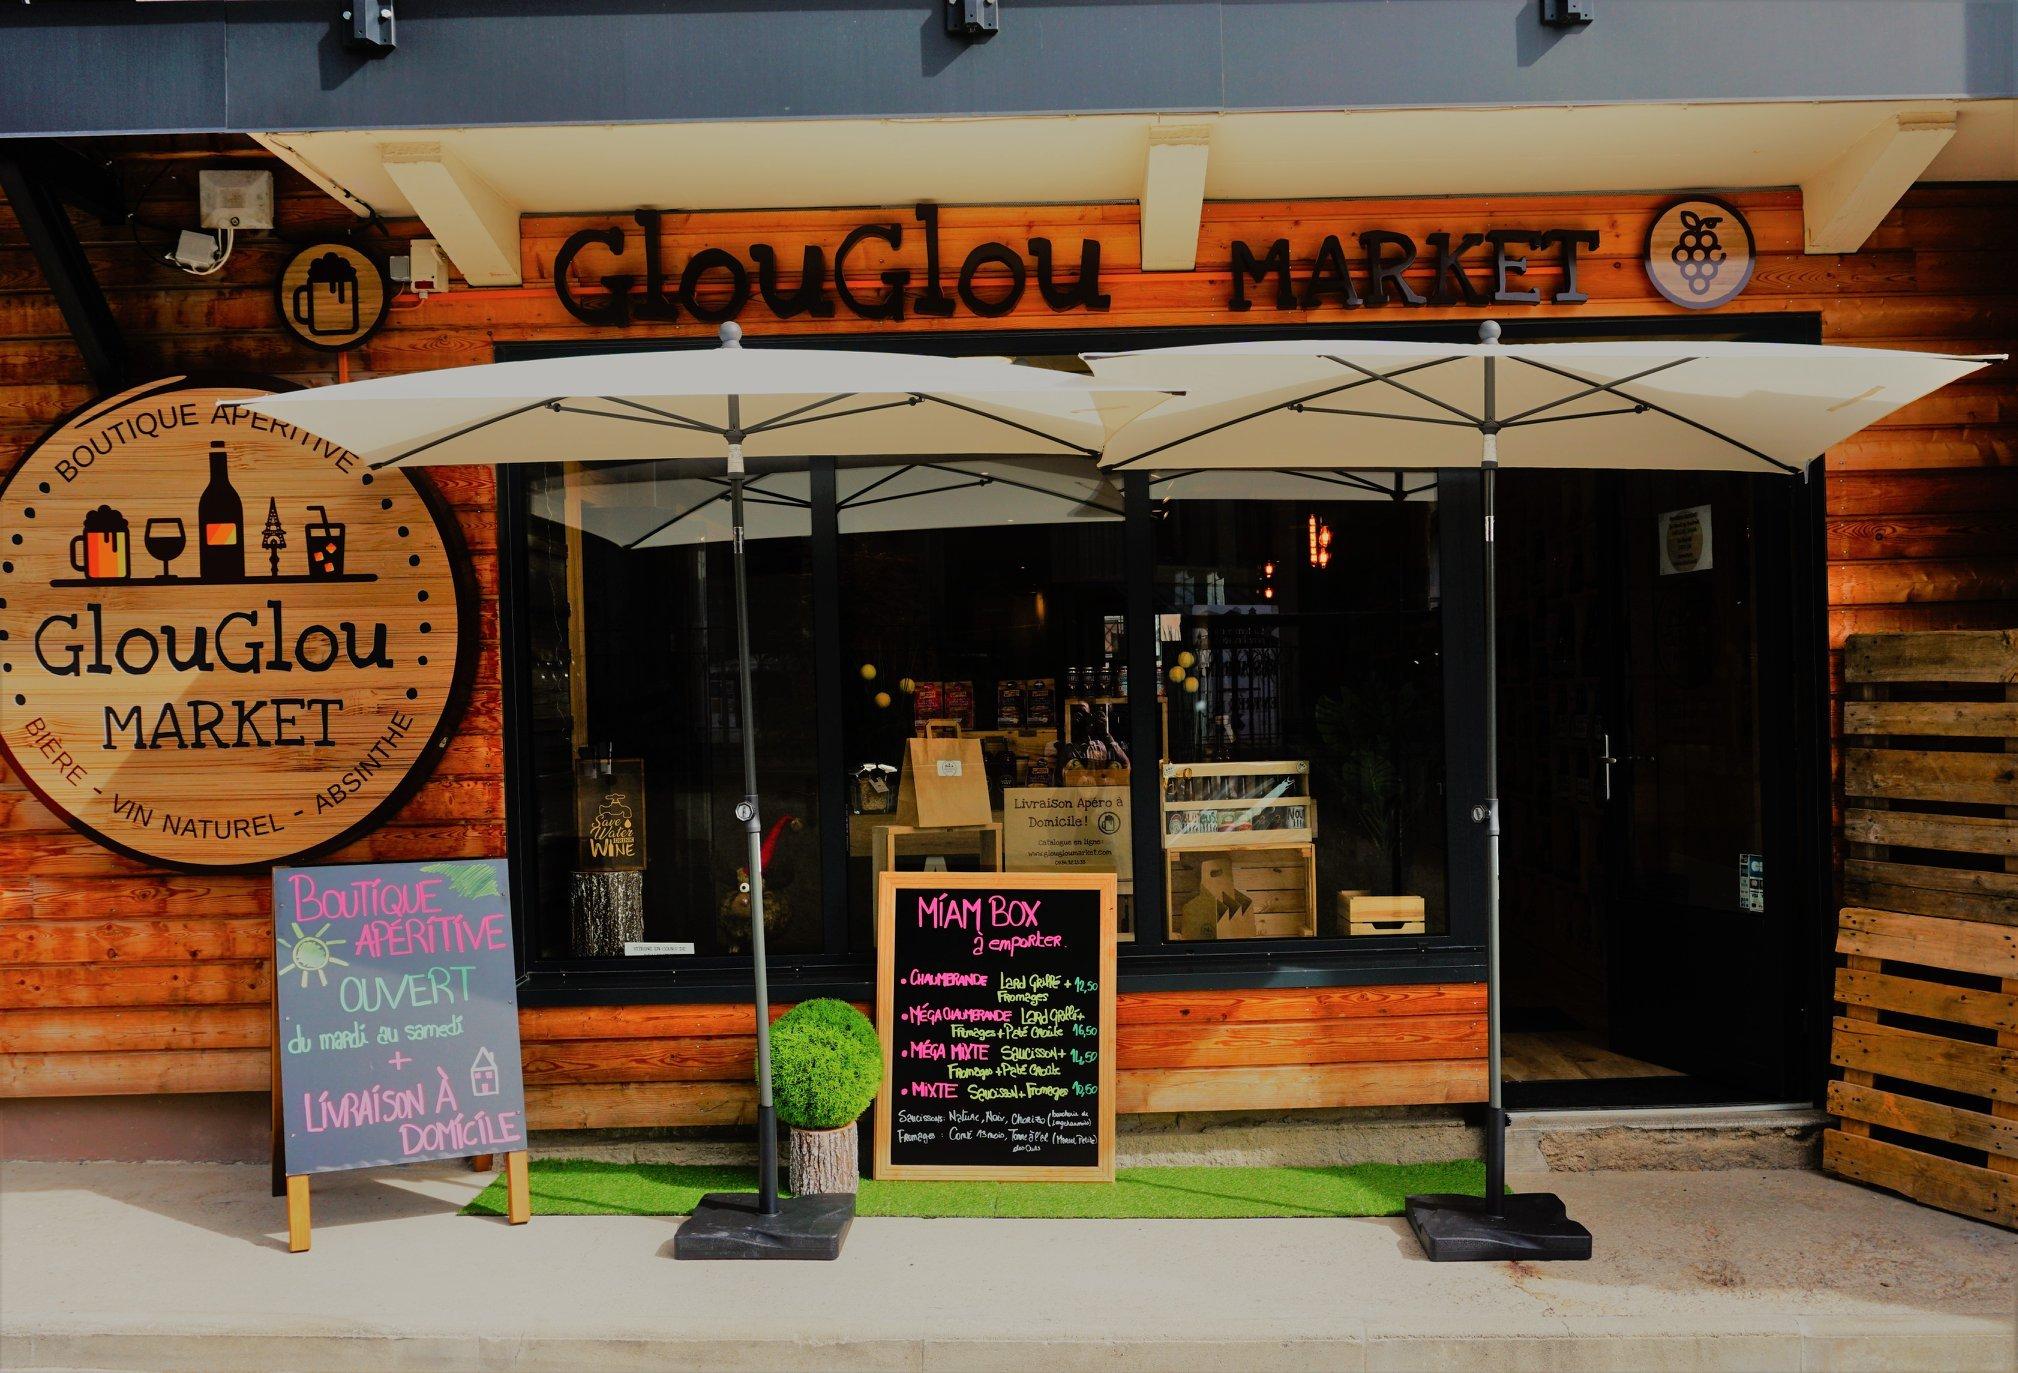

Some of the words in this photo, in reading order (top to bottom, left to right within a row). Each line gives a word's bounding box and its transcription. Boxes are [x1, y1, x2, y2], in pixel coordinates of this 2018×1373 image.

[555, 204, 1111, 327] GlouGlou
[1228, 230, 1600, 312] MARKET
[55, 403, 200, 483] BOUTIQUE
[35, 600, 394, 677] GlouGlou
[103, 698, 344, 750] MARKET
[25, 716, 88, 787] BIÈRE
[112, 793, 154, 827] VIN
[162, 813, 285, 839] NATUREL
[315, 710, 414, 815] ABSINTHE
[1014, 798, 1073, 809] Livraison
[1077, 797, 1112, 811] Apéro
[1116, 797, 1123, 807] à
[988, 895, 1041, 928] BOX
[339, 966, 476, 1012] OUVERT
[997, 990, 1049, 1006] Fromages
[1074, 976, 1099, 994] 12,50
[287, 1024, 311, 1054] du
[319, 1021, 368, 1050] mardi
[377, 1024, 399, 1045] au
[404, 1014, 464, 1042] samedi
[909, 1039, 947, 1061] MÉGA
[1072, 1023, 1098, 1038] 16,50
